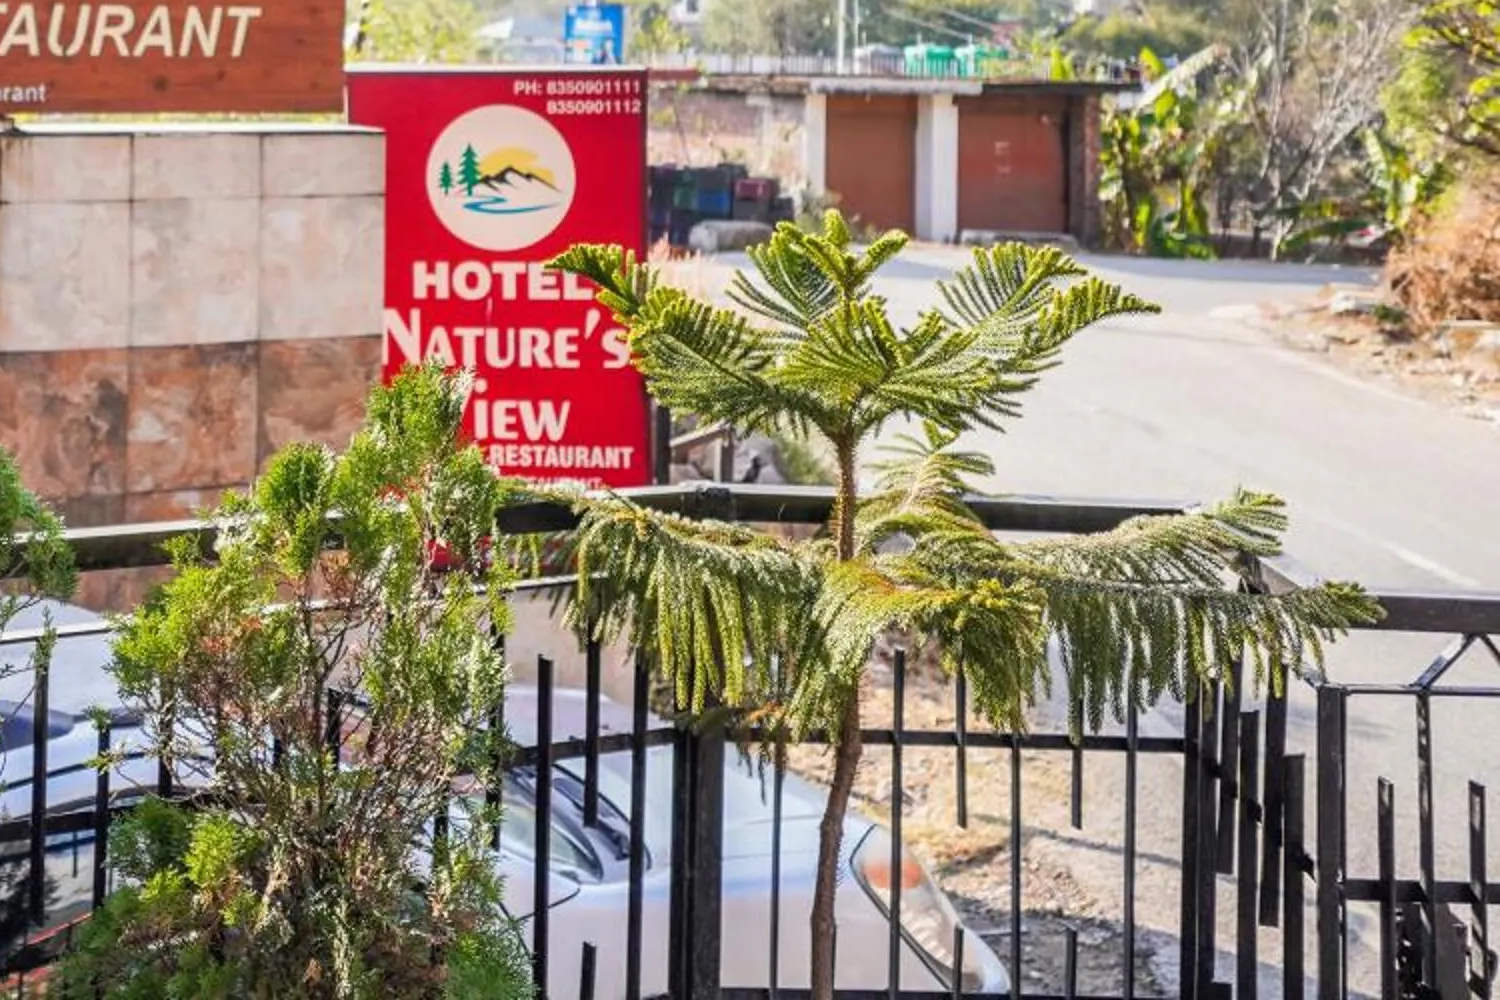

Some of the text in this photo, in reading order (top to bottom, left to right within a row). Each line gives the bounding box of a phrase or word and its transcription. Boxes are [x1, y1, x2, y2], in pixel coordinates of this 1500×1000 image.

[513, 79, 641, 96] PH: 8350901111
[546, 98, 642, 115] 8350901112
[412, 260, 595, 301] HOTEL
[490, 444, 635, 470] RESTAURANT
